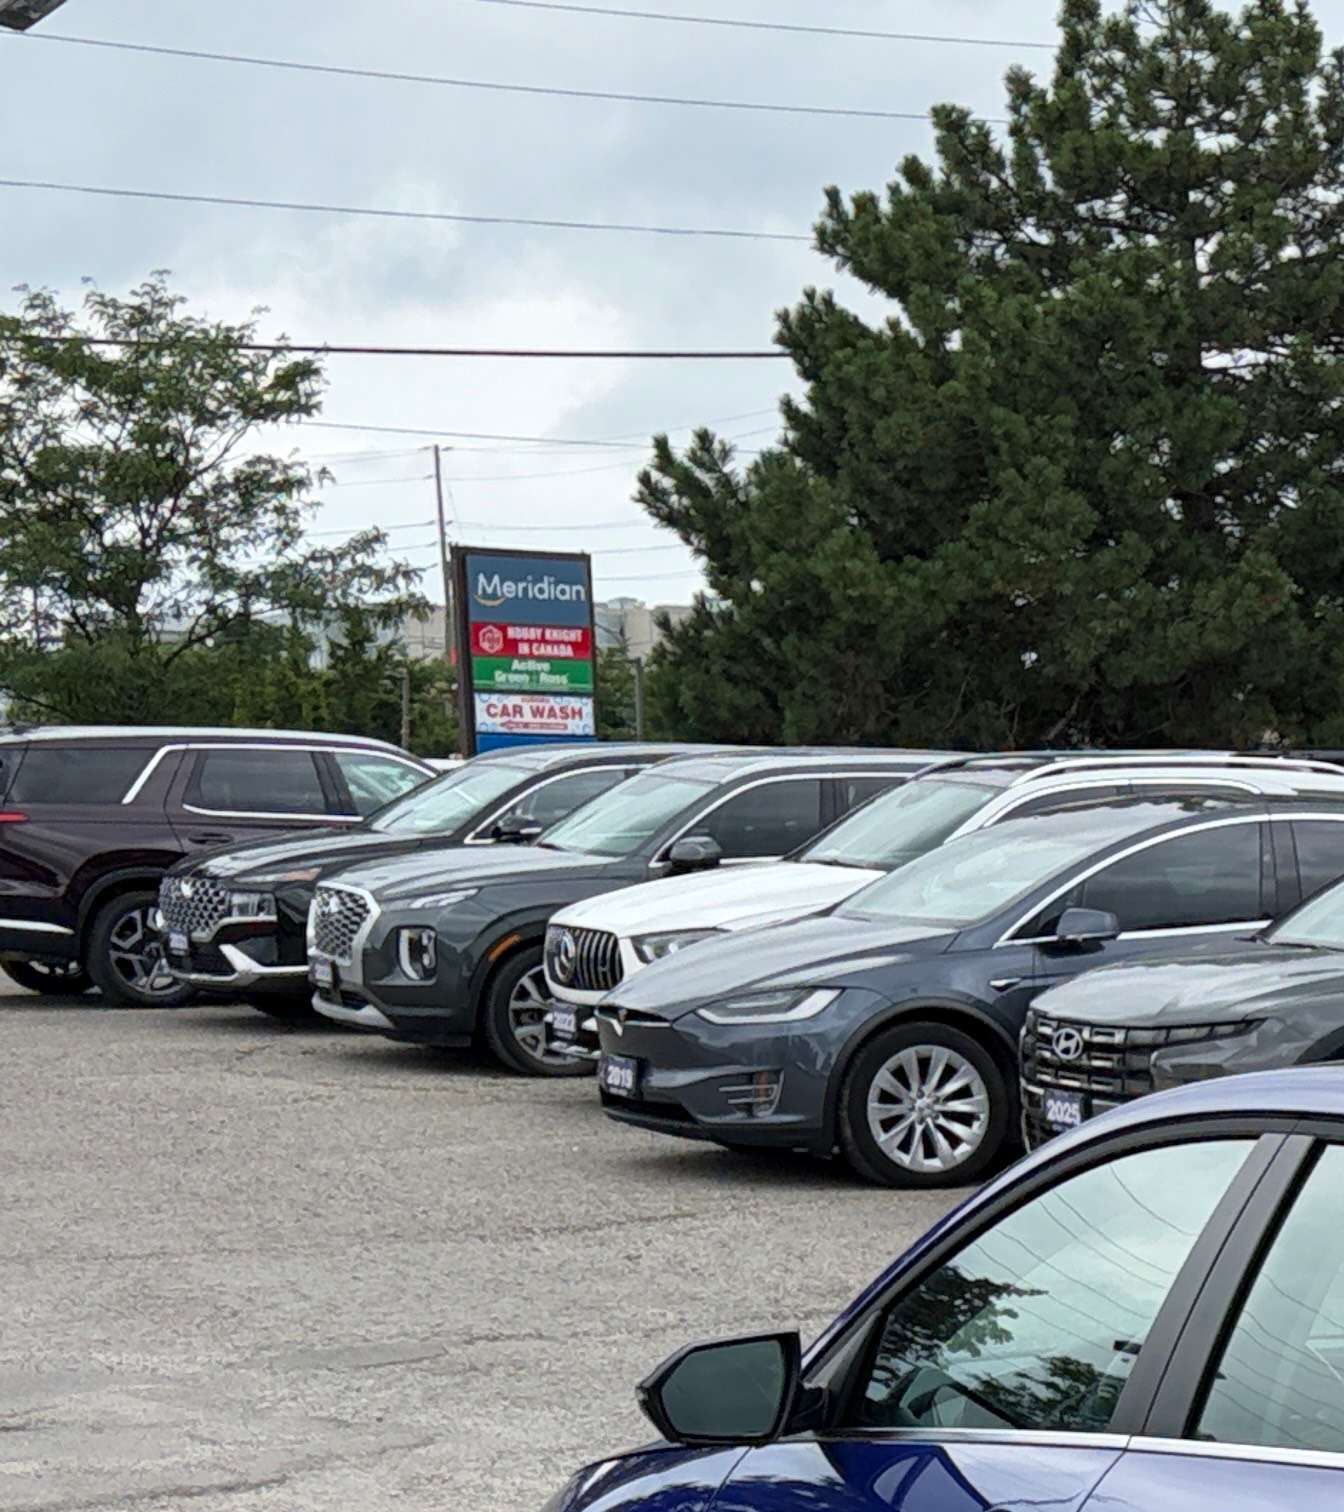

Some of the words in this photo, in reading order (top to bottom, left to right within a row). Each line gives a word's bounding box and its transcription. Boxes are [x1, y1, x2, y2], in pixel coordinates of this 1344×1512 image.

[477, 572, 586, 602] Meridian
[532, 643, 574, 657] CANADA
[511, 660, 550, 672] Active
[485, 703, 524, 718] CAR
[530, 704, 584, 720] WASH
[1045, 1098, 1082, 1129] 2025
